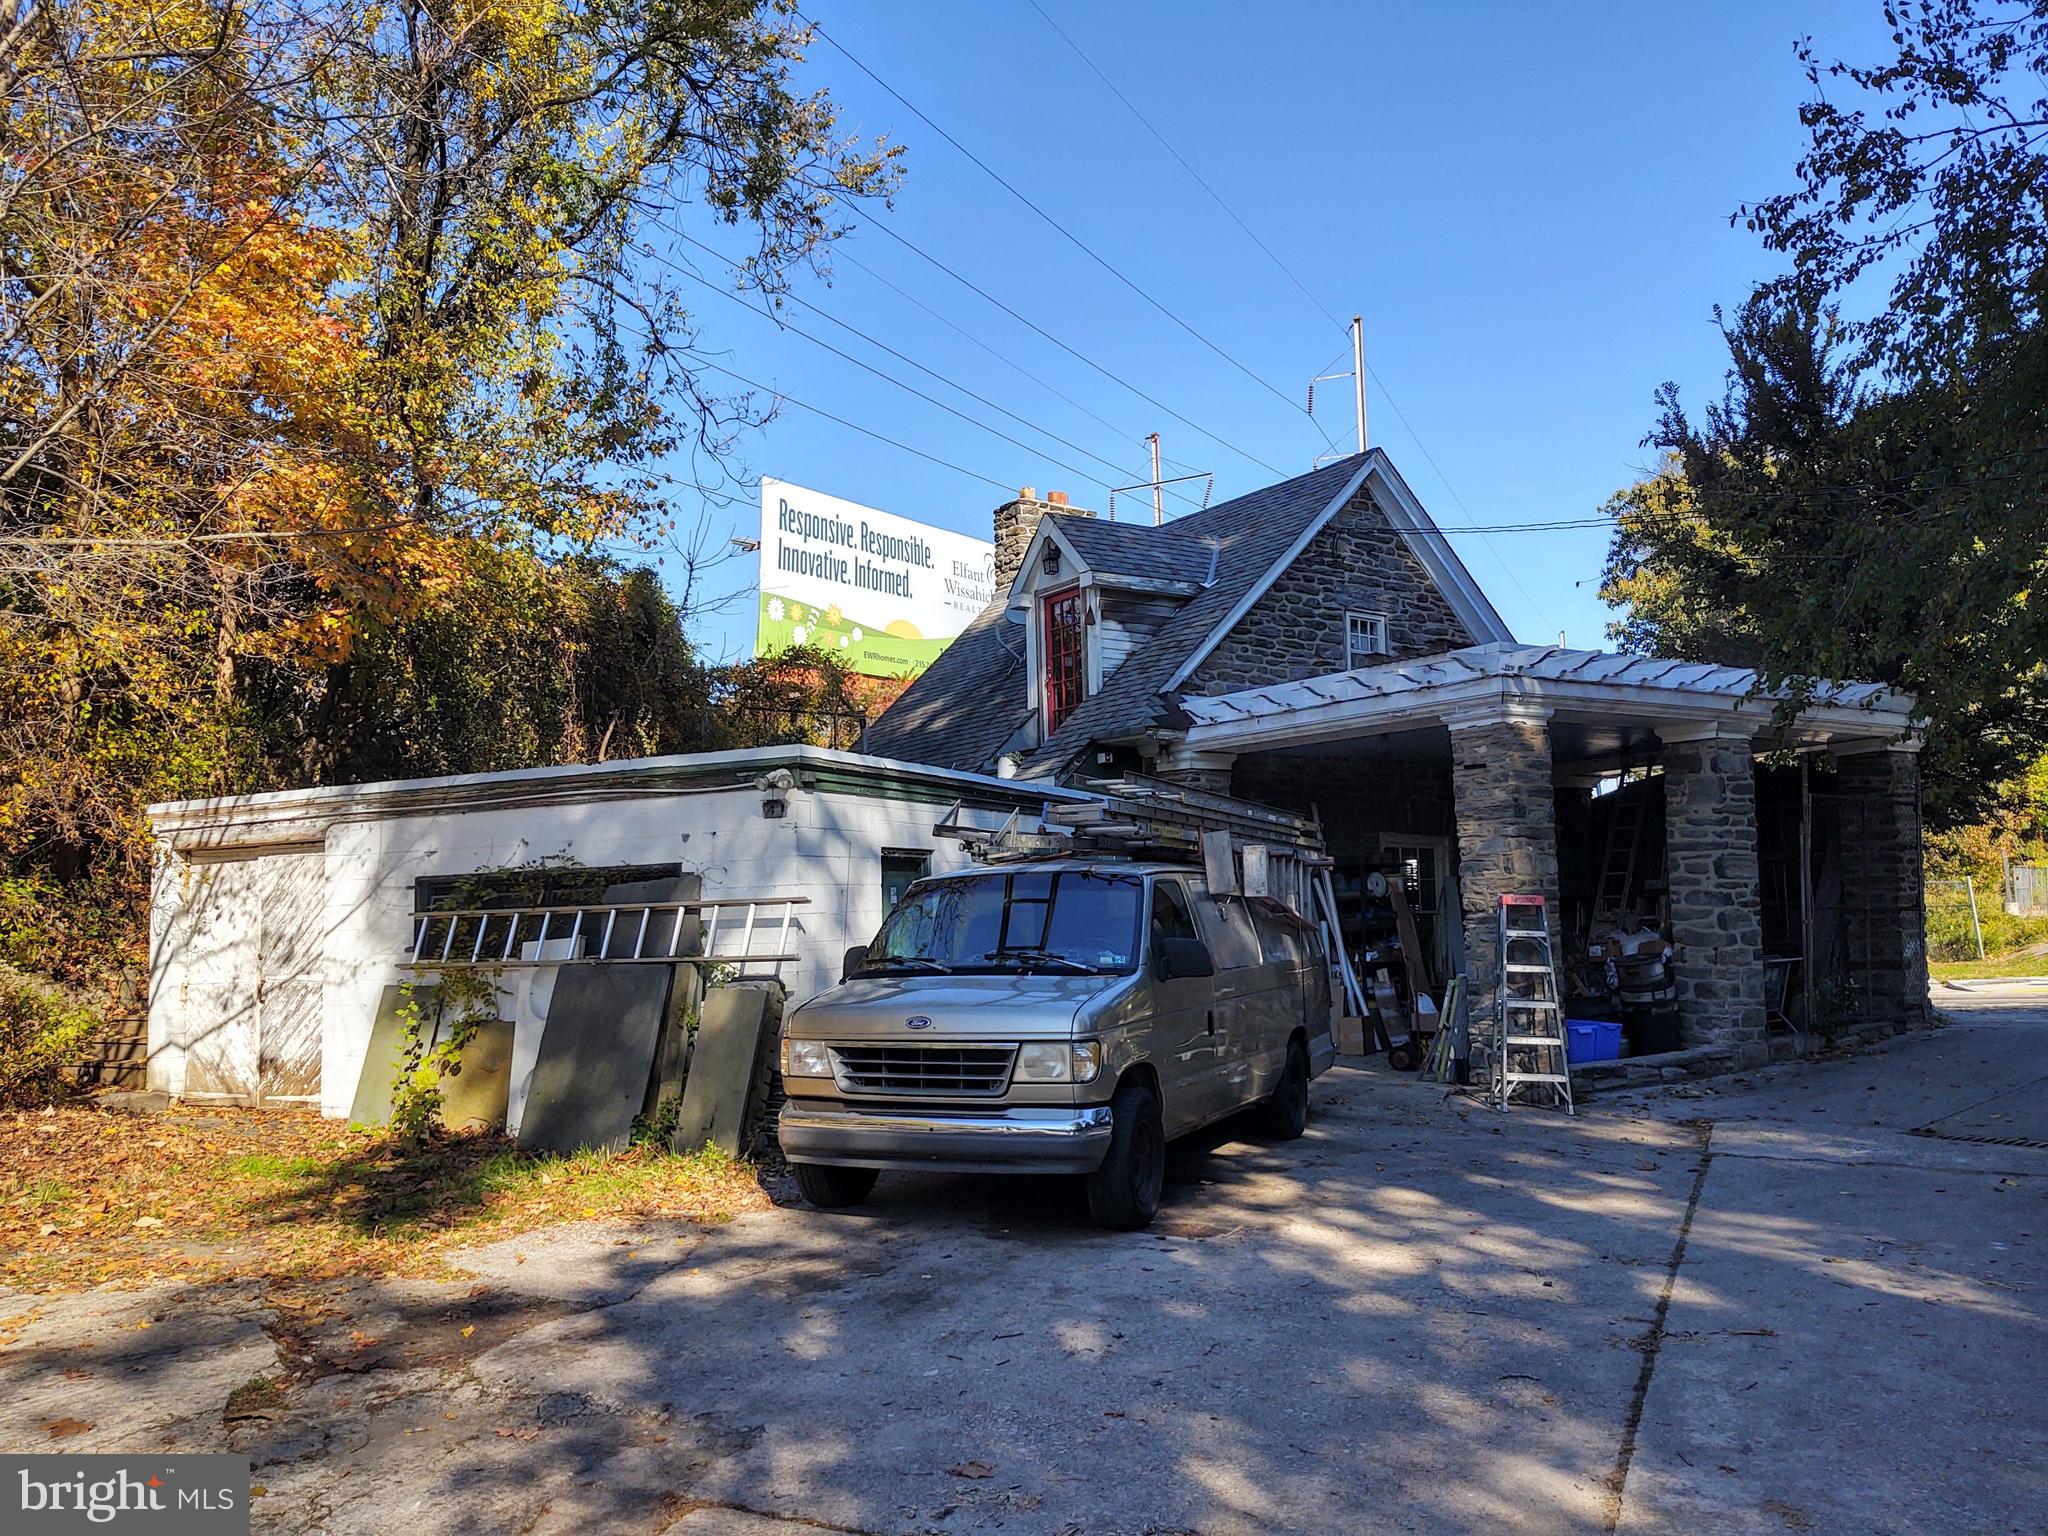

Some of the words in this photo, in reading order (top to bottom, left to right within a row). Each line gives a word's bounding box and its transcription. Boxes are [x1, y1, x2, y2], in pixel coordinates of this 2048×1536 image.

[779, 498, 857, 549] Responsive.
[860, 521, 935, 569] Responsible.
[778, 537, 851, 585] Innovative.
[854, 556, 913, 599] Informed.
[952, 560, 984, 583] Elfant
[953, 601, 982, 614] REALT
[863, 651, 909, 666] EWRhomes.com
